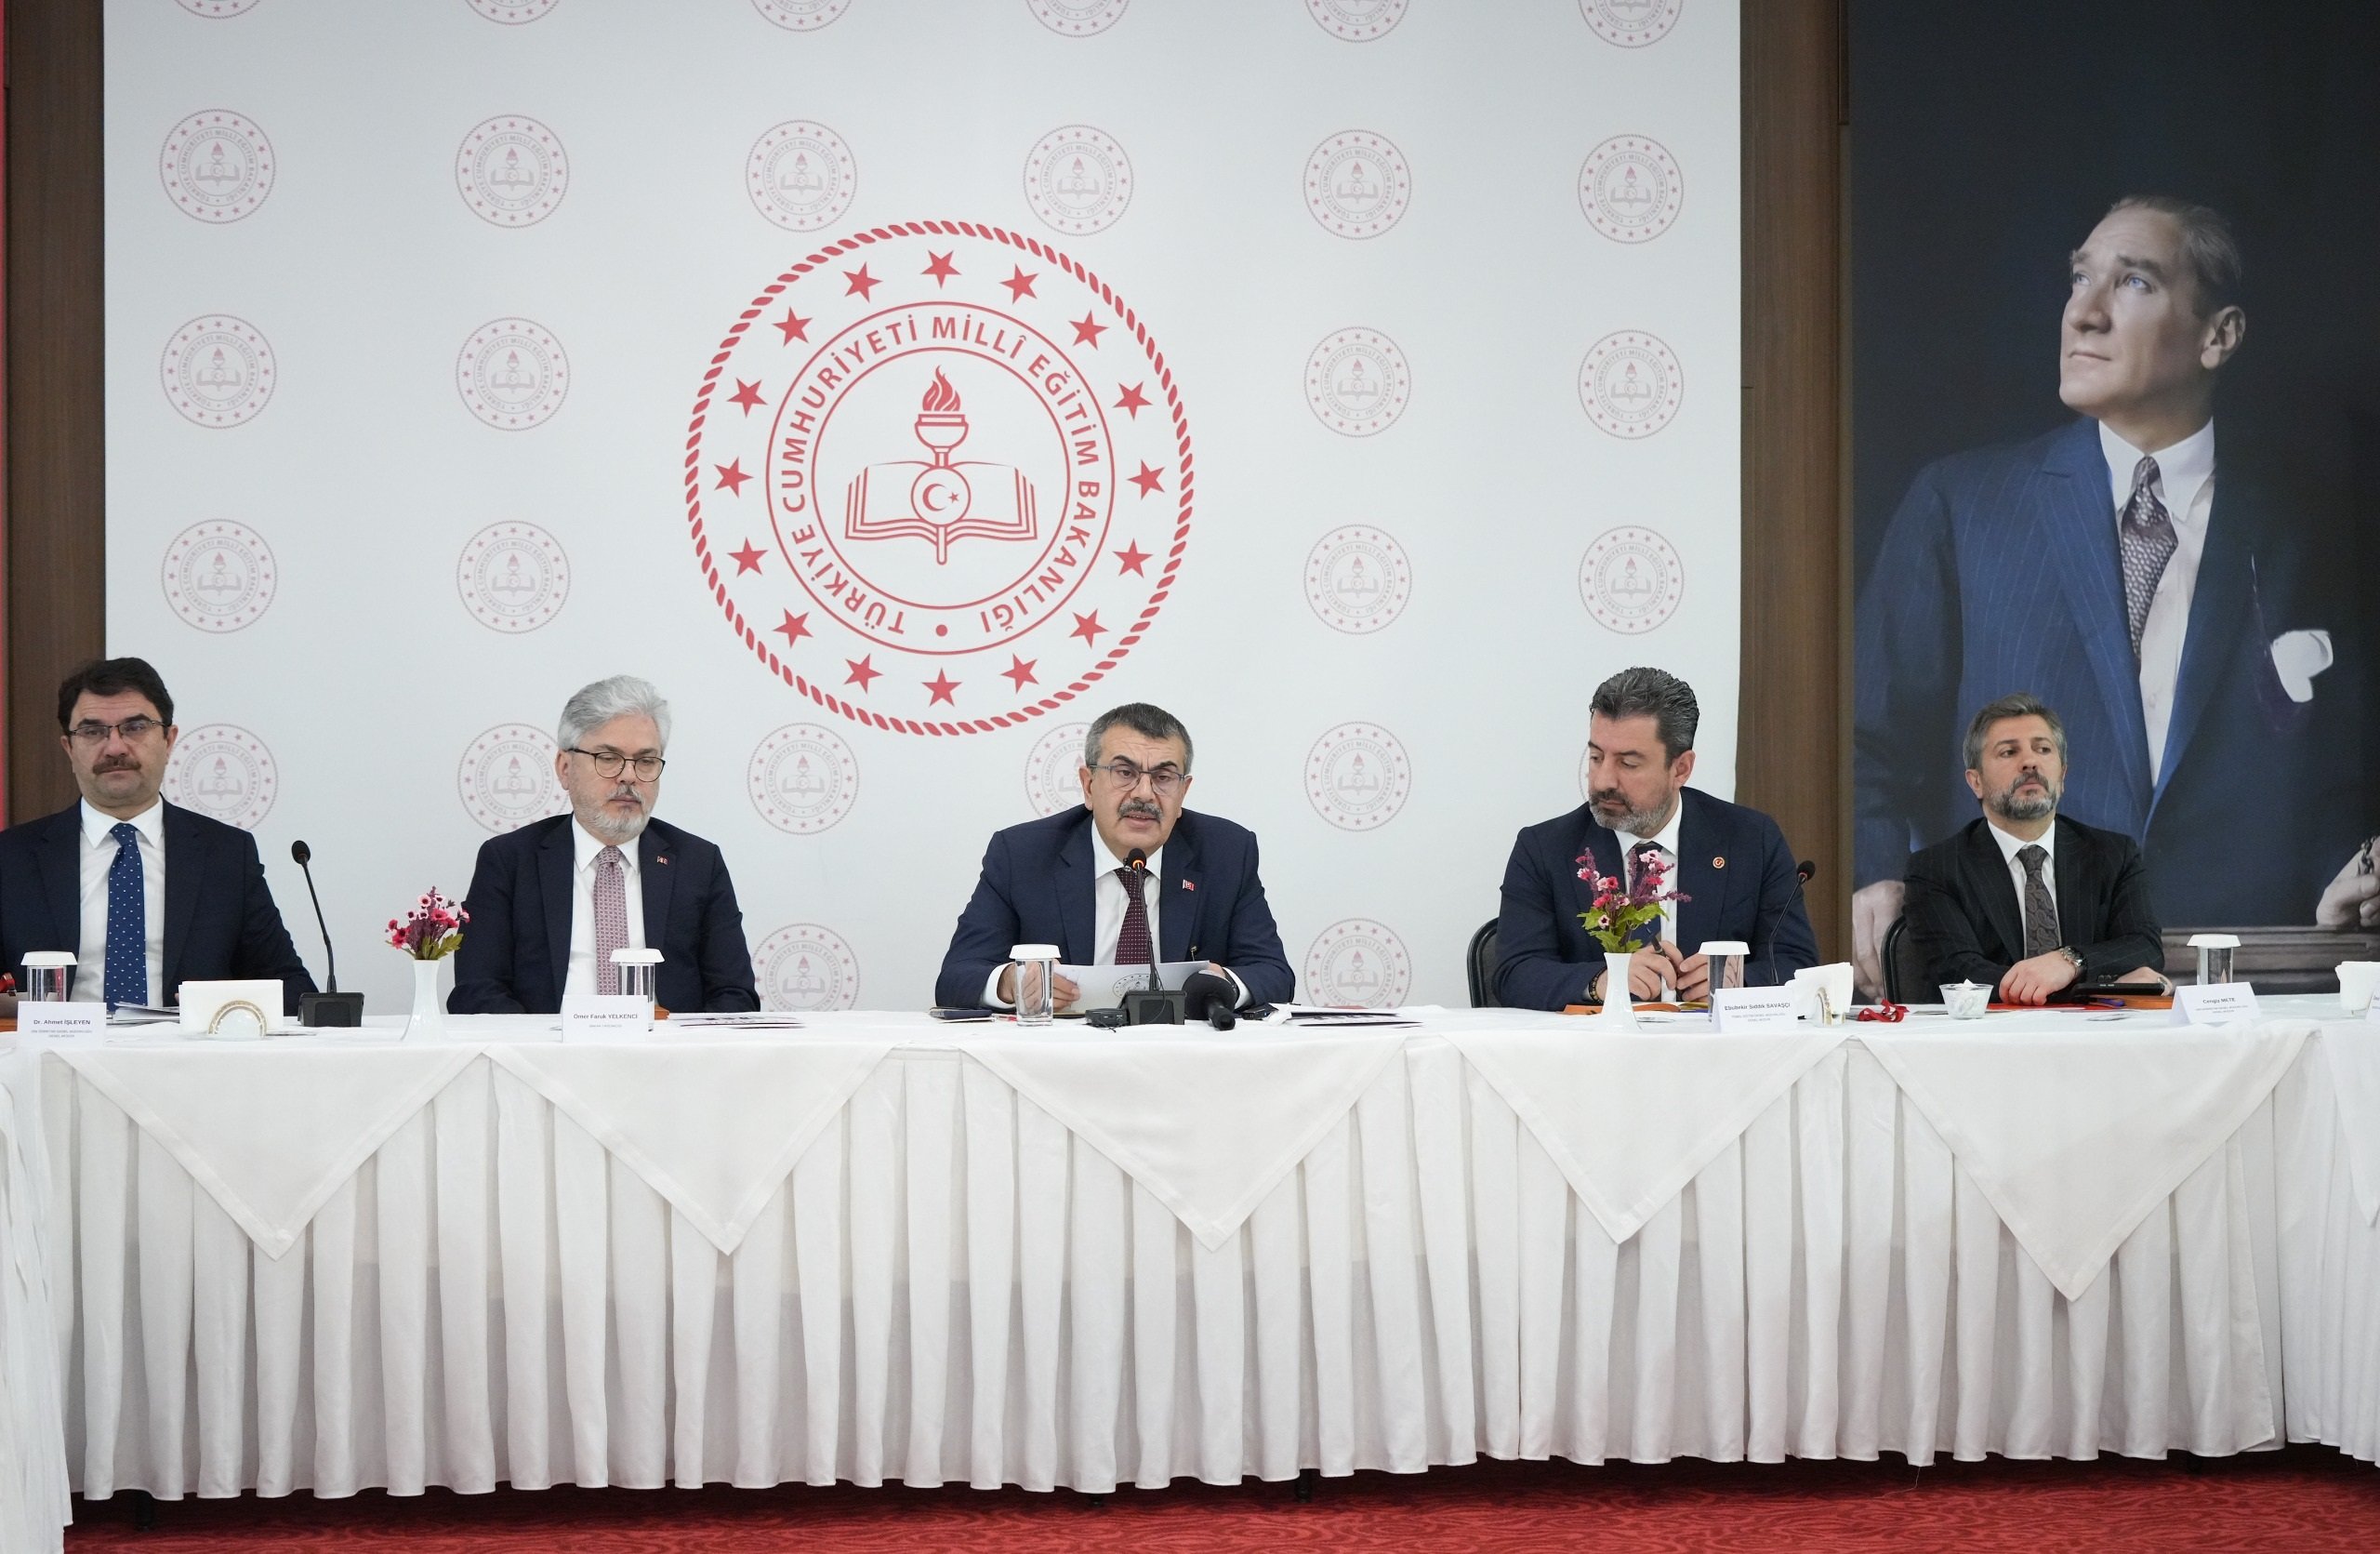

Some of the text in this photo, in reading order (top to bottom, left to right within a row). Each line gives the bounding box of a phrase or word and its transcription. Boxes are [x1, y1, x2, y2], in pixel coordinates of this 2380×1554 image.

[782, 316, 918, 512] CUMHURİYETİ
[1029, 354, 1100, 465] EĞİTİM
[793, 525, 904, 635] TÜRKİYE
[982, 481, 1102, 632] BAKANLIĞI
